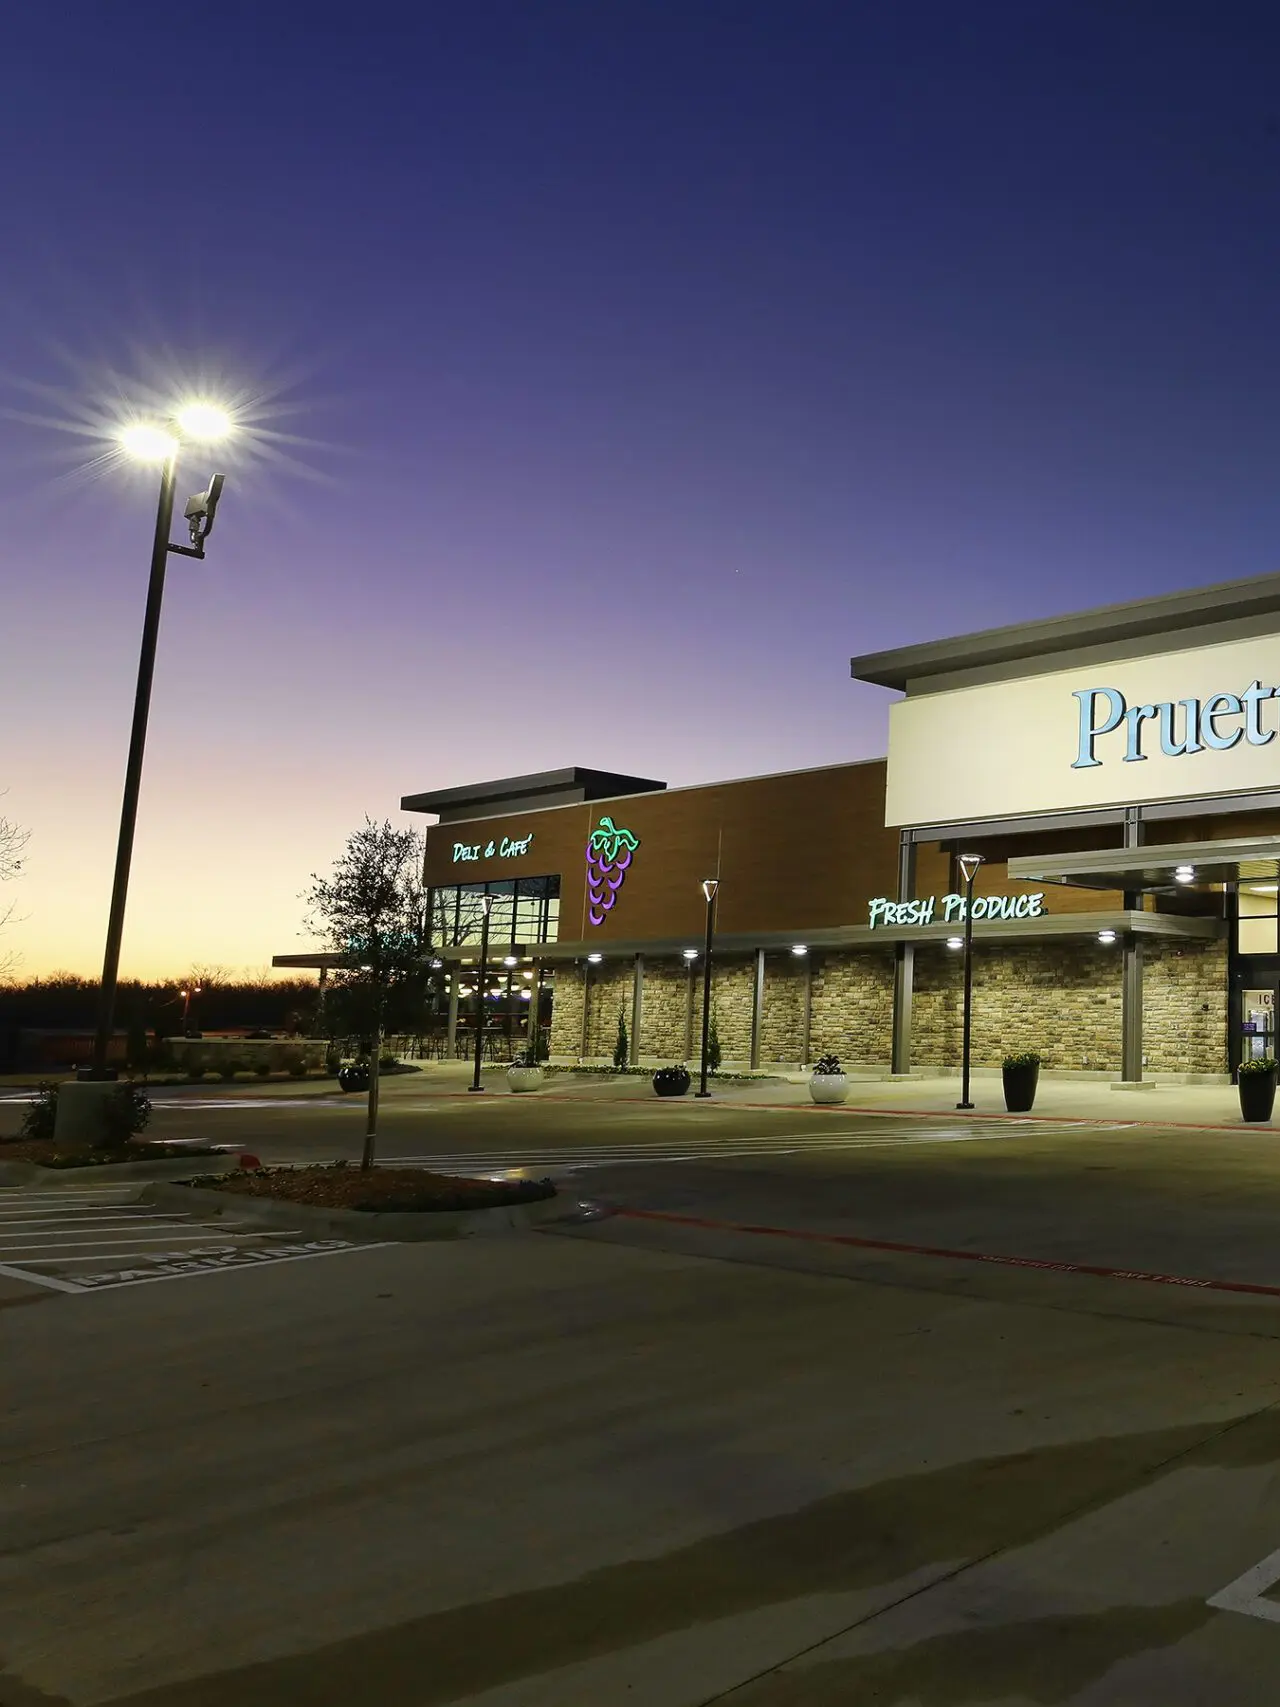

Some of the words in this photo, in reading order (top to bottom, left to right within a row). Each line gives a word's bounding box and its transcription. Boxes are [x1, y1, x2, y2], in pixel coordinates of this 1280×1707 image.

[452, 842, 481, 863] DELI
[484, 840, 496, 858] &
[868, 895, 936, 930] FRESH
[71, 1240, 354, 1286] PARKING
